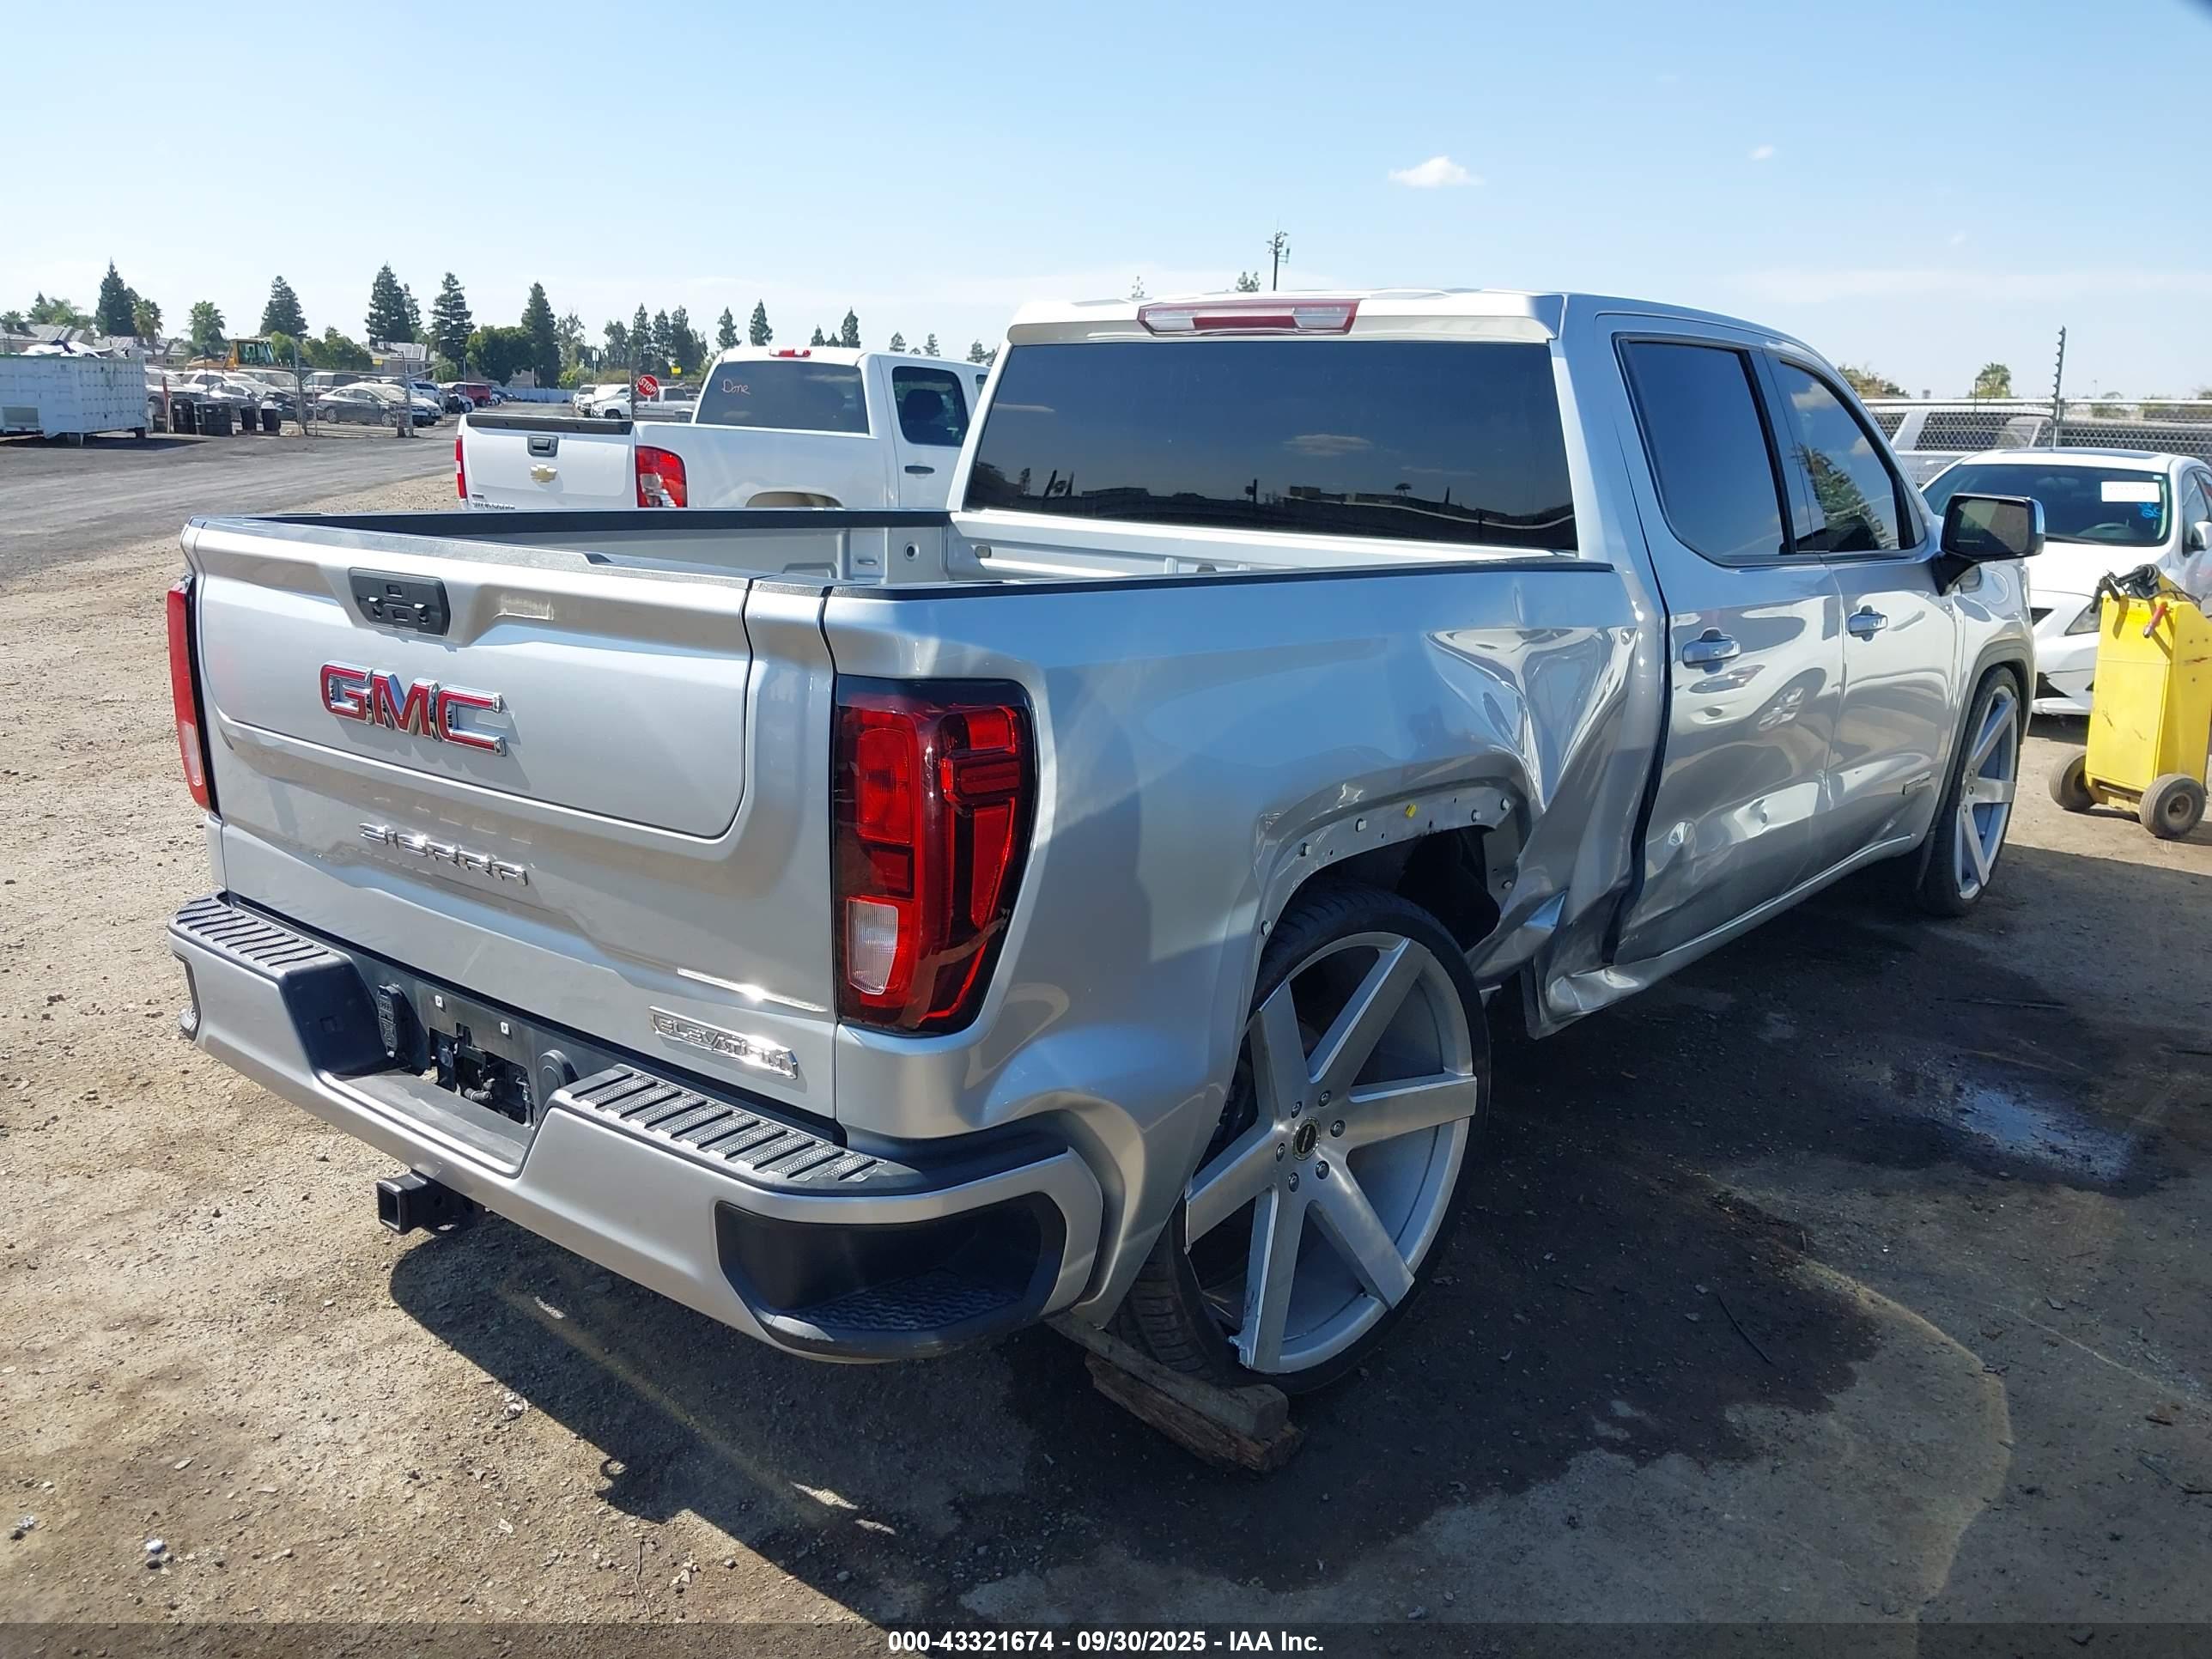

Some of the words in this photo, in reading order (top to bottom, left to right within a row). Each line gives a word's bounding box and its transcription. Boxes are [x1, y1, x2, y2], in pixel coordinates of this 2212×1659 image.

[638, 377, 657, 393] STOP
[319, 659, 507, 757] GMC
[359, 822, 528, 886] SIERRA
